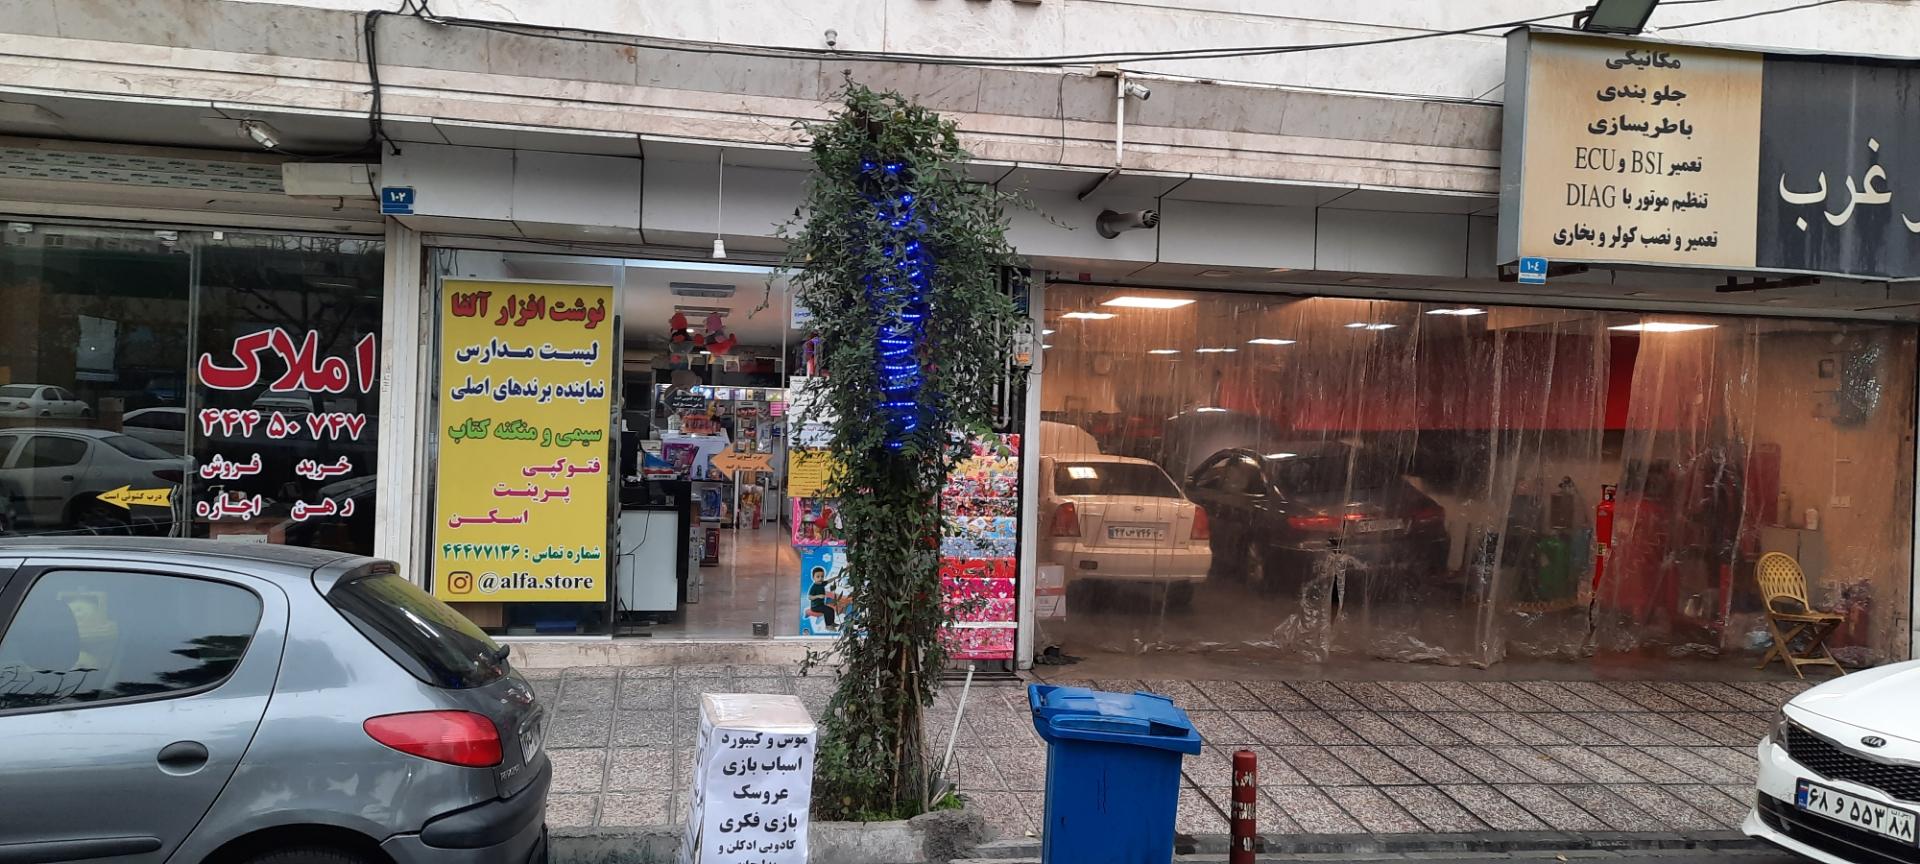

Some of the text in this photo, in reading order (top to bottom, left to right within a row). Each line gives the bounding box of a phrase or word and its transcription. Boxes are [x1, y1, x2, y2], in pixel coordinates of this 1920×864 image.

[1605, 49, 1681, 70] مکانیکی
[1596, 84, 1687, 106] جلو بندی
[1588, 115, 1693, 140] باطریسازی
[1574, 147, 1702, 176] تعمیر BSI و ECU
[1779, 138, 1892, 231] غرب
[390, 191, 406, 202] ۱۰۲
[1566, 183, 1708, 212] تنظیم موتور با DIAG
[1553, 223, 1718, 251] تعمیر و نصب کولر و بخاری
[451, 291, 605, 328] نوشت افزار آلفا
[198, 327, 376, 394] املاک
[456, 337, 599, 365] لیست مدارس
[451, 377, 604, 403] نماینده برندهای اصلی
[200, 408, 366, 440] ۴۴۴ ۵۰ ۷۴۷
[448, 417, 602, 446] سیمی و منگنه کتاب
[200, 453, 352, 480] خرید فروش
[522, 457, 601, 478] فتوکپی
[493, 482, 570, 503] پرینت
[196, 494, 354, 521] رهن اجاره
[448, 509, 529, 528] اسکن
[442, 543, 520, 560] ۴۴۴۷۷۱۳۶
[532, 545, 564, 563] تماس
[566, 546, 601, 564] شماره
[478, 572, 594, 594] @alfa.store
[721, 732, 808, 749] موس و کیبورد
[1863, 737, 1884, 747] KIA
[722, 756, 802, 776] اسباب بازی
[733, 784, 789, 804] عروسک
[719, 812, 797, 833] بازی فکری
[1808, 788, 1828, 812] ۶۸
[1850, 801, 1885, 828] ۵۵۳
[1889, 817, 1911, 839] ۸۸
[718, 844, 724, 854] و
[726, 840, 756, 854] ادکلن
